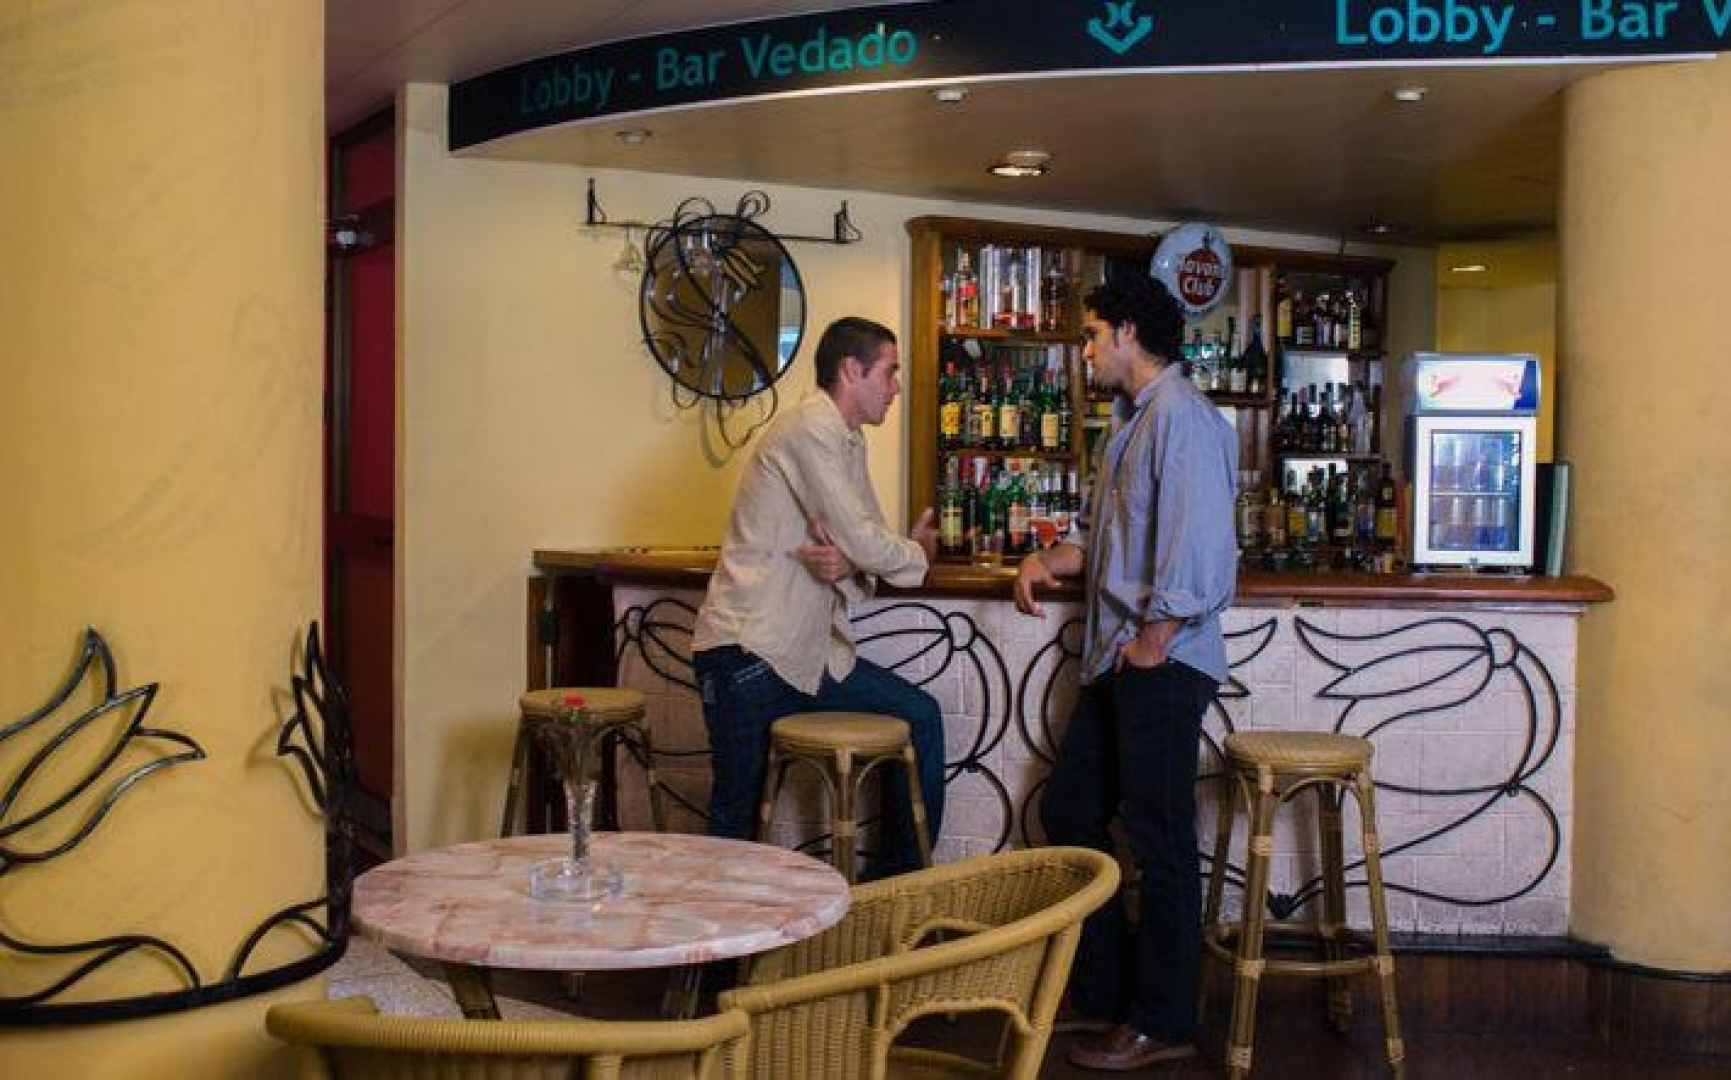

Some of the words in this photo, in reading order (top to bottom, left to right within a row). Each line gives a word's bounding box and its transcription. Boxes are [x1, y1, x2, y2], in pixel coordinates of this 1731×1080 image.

[1335, 0, 1515, 54] Lobby
[1581, 0, 1678, 39] Bar
[519, 61, 615, 116] Lobby
[656, 47, 726, 90] Bar
[740, 22, 917, 79] Vedado
